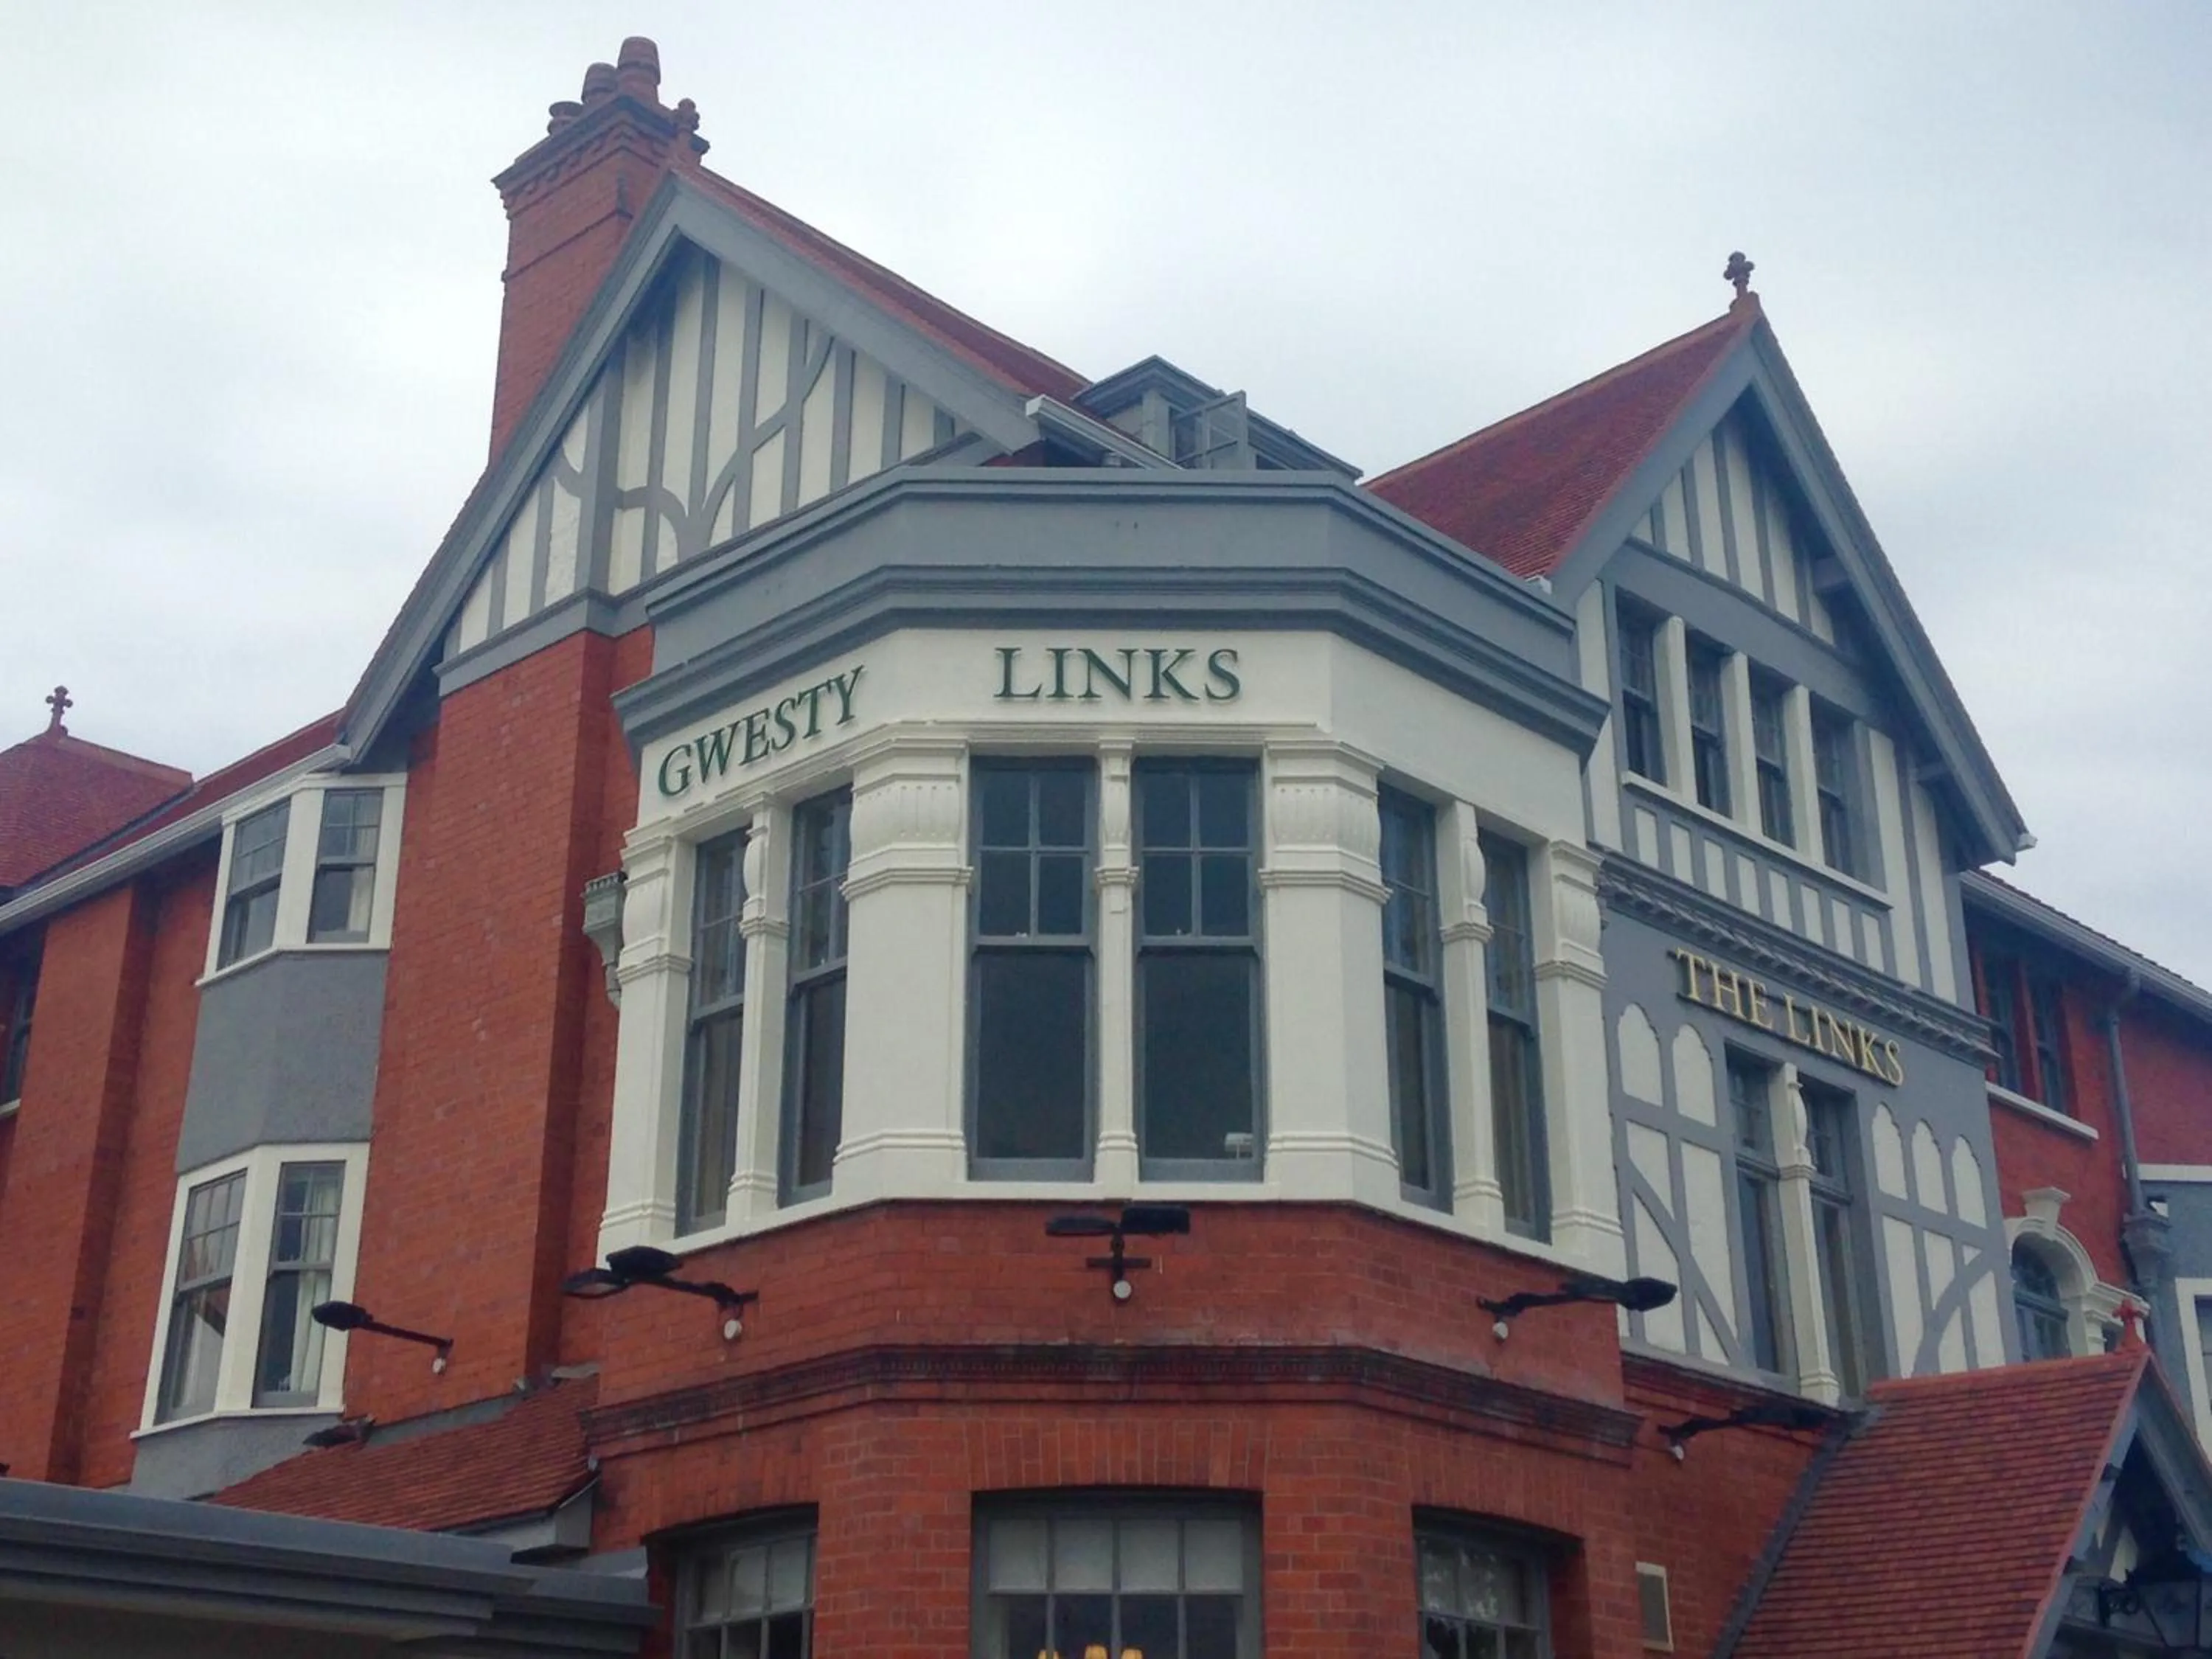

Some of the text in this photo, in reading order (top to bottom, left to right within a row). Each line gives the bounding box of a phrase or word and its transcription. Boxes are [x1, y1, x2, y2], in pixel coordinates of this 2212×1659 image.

[658, 647, 1241, 796] GWESTY LINKS
[1676, 947, 1903, 1087] THE LINKS
